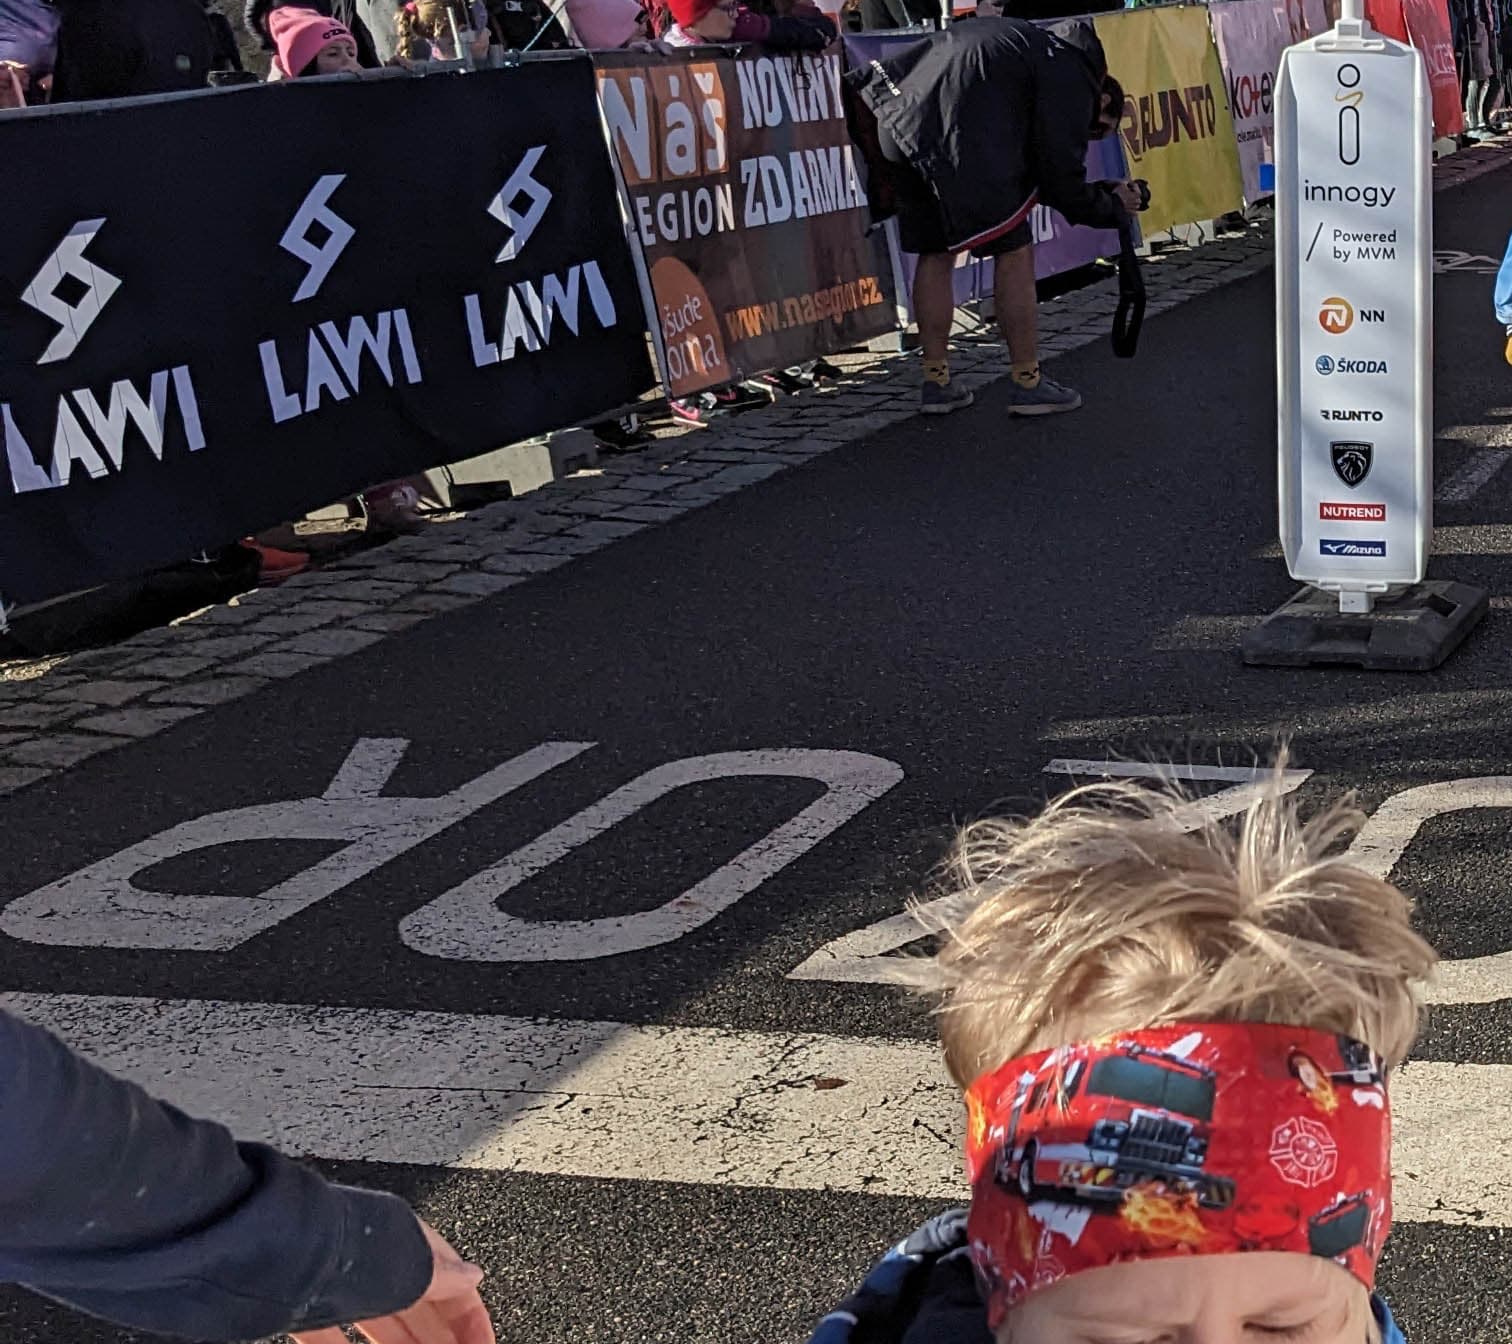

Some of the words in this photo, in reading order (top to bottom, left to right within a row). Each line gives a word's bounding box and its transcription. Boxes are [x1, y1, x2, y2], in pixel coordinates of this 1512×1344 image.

[736, 55, 844, 129] NOVINY
[1142, 83, 1216, 156] RUNTO
[602, 72, 727, 181] Náš
[741, 145, 868, 228] ZDARMA
[1305, 179, 1397, 208] innogy
[636, 183, 735, 246] EGION
[1333, 229, 1397, 244] Powered
[1333, 247, 1350, 263] by
[1357, 247, 1396, 260] MVM
[464, 260, 618, 368] LAWI
[1360, 310, 1385, 323] NN
[259, 309, 423, 424] LAWI
[667, 334, 721, 382] oma
[1337, 358, 1388, 375] ŠKODA
[2, 364, 206, 494] LAWI
[1332, 409, 1383, 422] RUNTO
[1323, 506, 1383, 519] NUTREND
